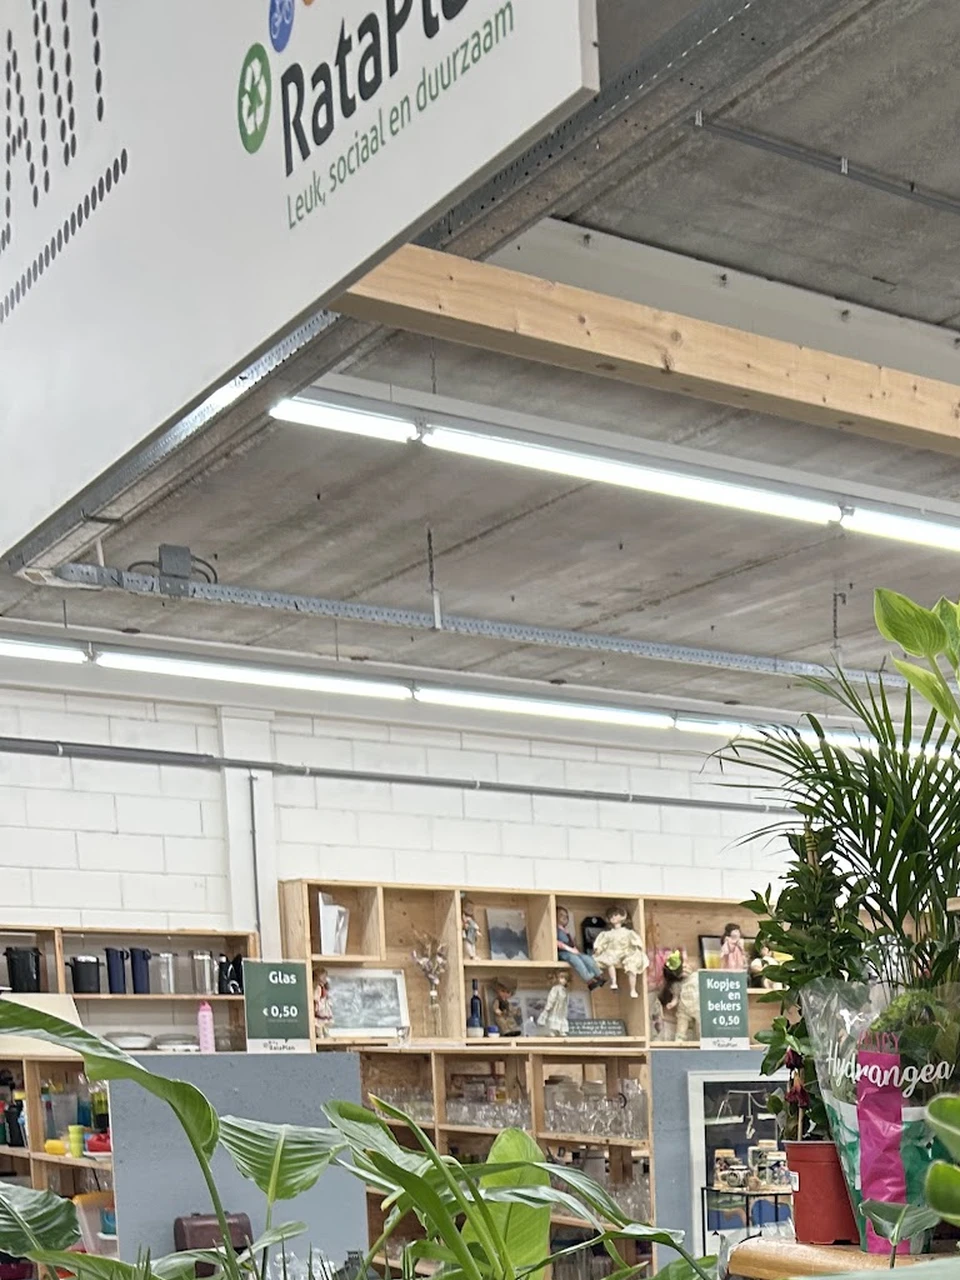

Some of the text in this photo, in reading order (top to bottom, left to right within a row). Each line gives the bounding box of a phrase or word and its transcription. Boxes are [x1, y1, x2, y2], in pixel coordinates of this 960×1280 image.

[281, 0, 469, 177] RataP
[287, 0, 514, 230] Leuk, sociaal en duurzaam
[269, 971, 297, 984] Glas
[706, 978, 740, 991] Kopjes
[728, 992, 740, 1000] en
[271, 1005, 298, 1018] 0,50
[707, 1000, 741, 1011] bekers
[719, 1015, 740, 1026] 0,50
[825, 1039, 956, 1099] Hydrangea
